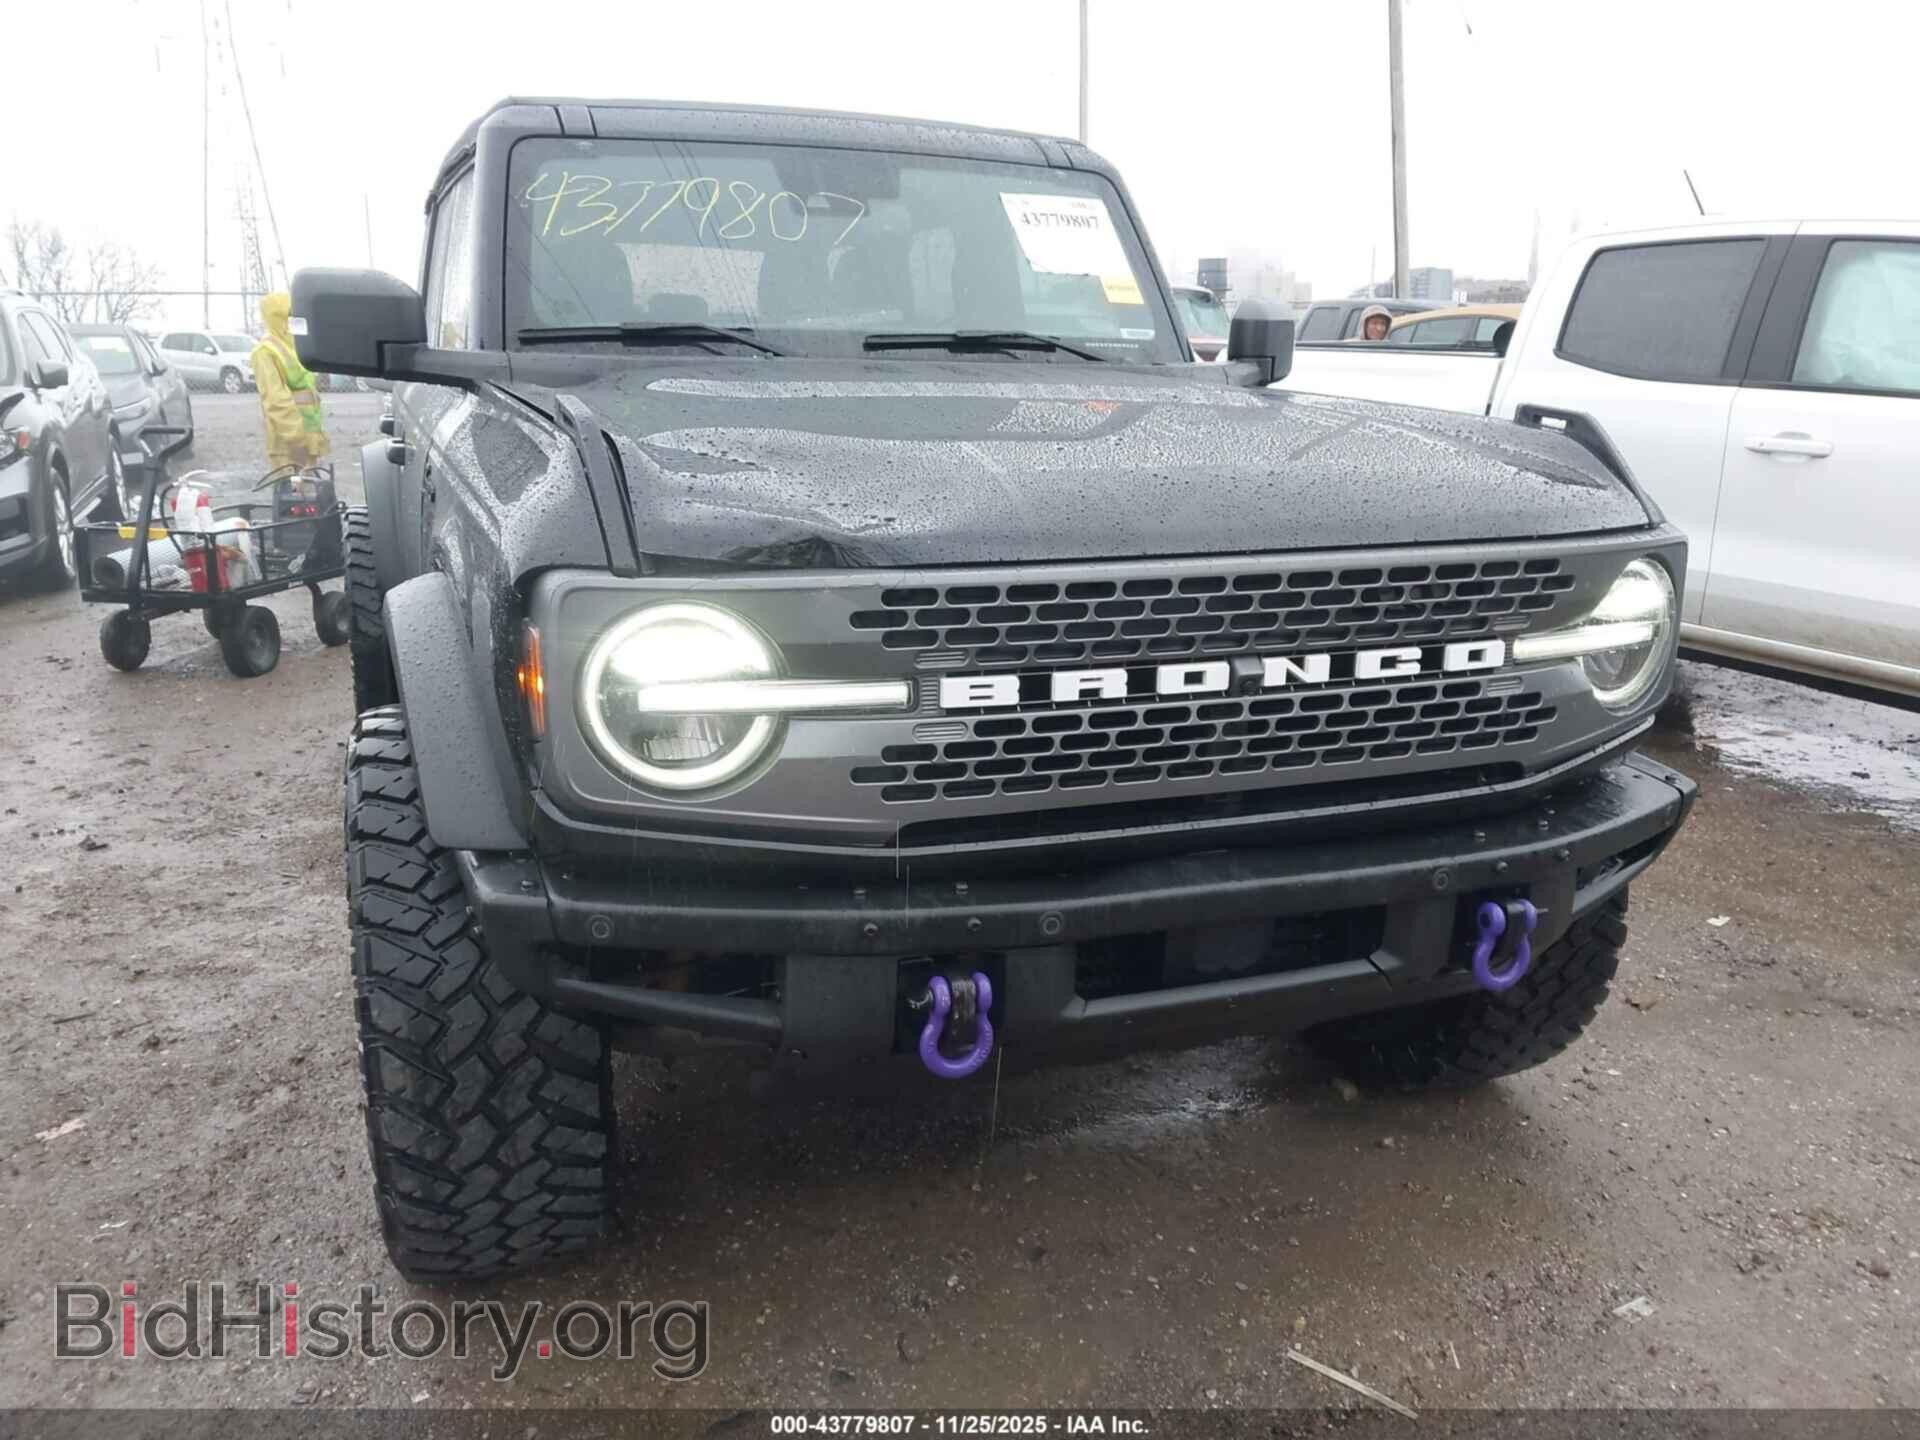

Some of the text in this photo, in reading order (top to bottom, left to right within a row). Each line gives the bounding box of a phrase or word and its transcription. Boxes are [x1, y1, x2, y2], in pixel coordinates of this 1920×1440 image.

[525, 171, 866, 245] 43779807
[1021, 211, 1101, 229] 43779807
[938, 639, 1506, 709] BRONCO
